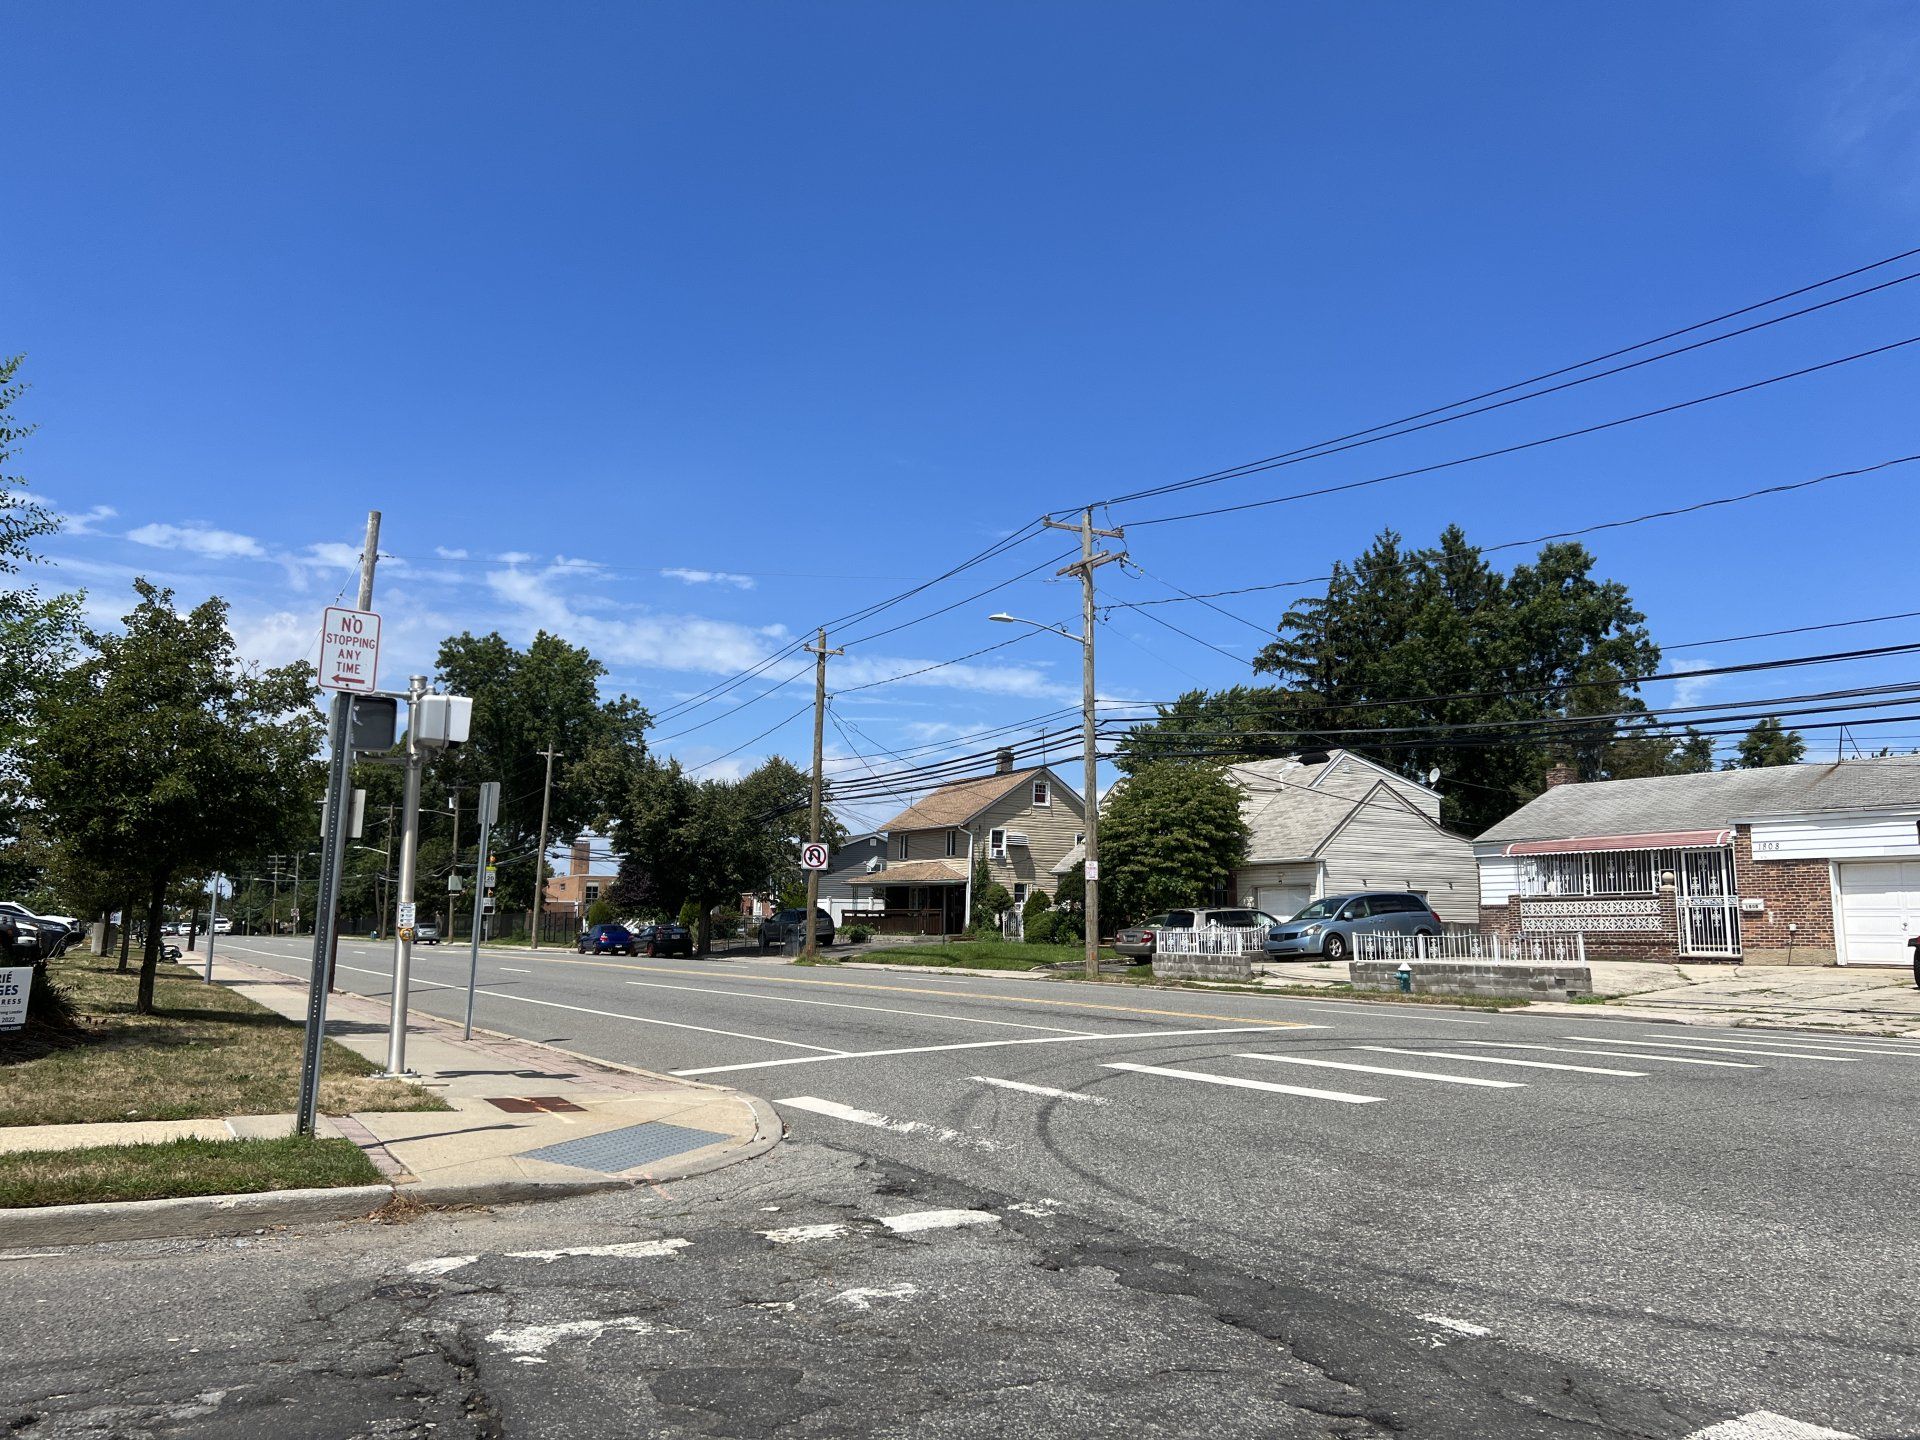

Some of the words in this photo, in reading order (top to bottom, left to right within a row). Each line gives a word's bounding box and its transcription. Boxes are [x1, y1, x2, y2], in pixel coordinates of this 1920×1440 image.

[341, 617, 363, 634] NO
[326, 633, 376, 650] STOPPING
[338, 649, 361, 661] ANY
[336, 661, 361, 675] TIME
[1758, 842, 1780, 850] 1808
